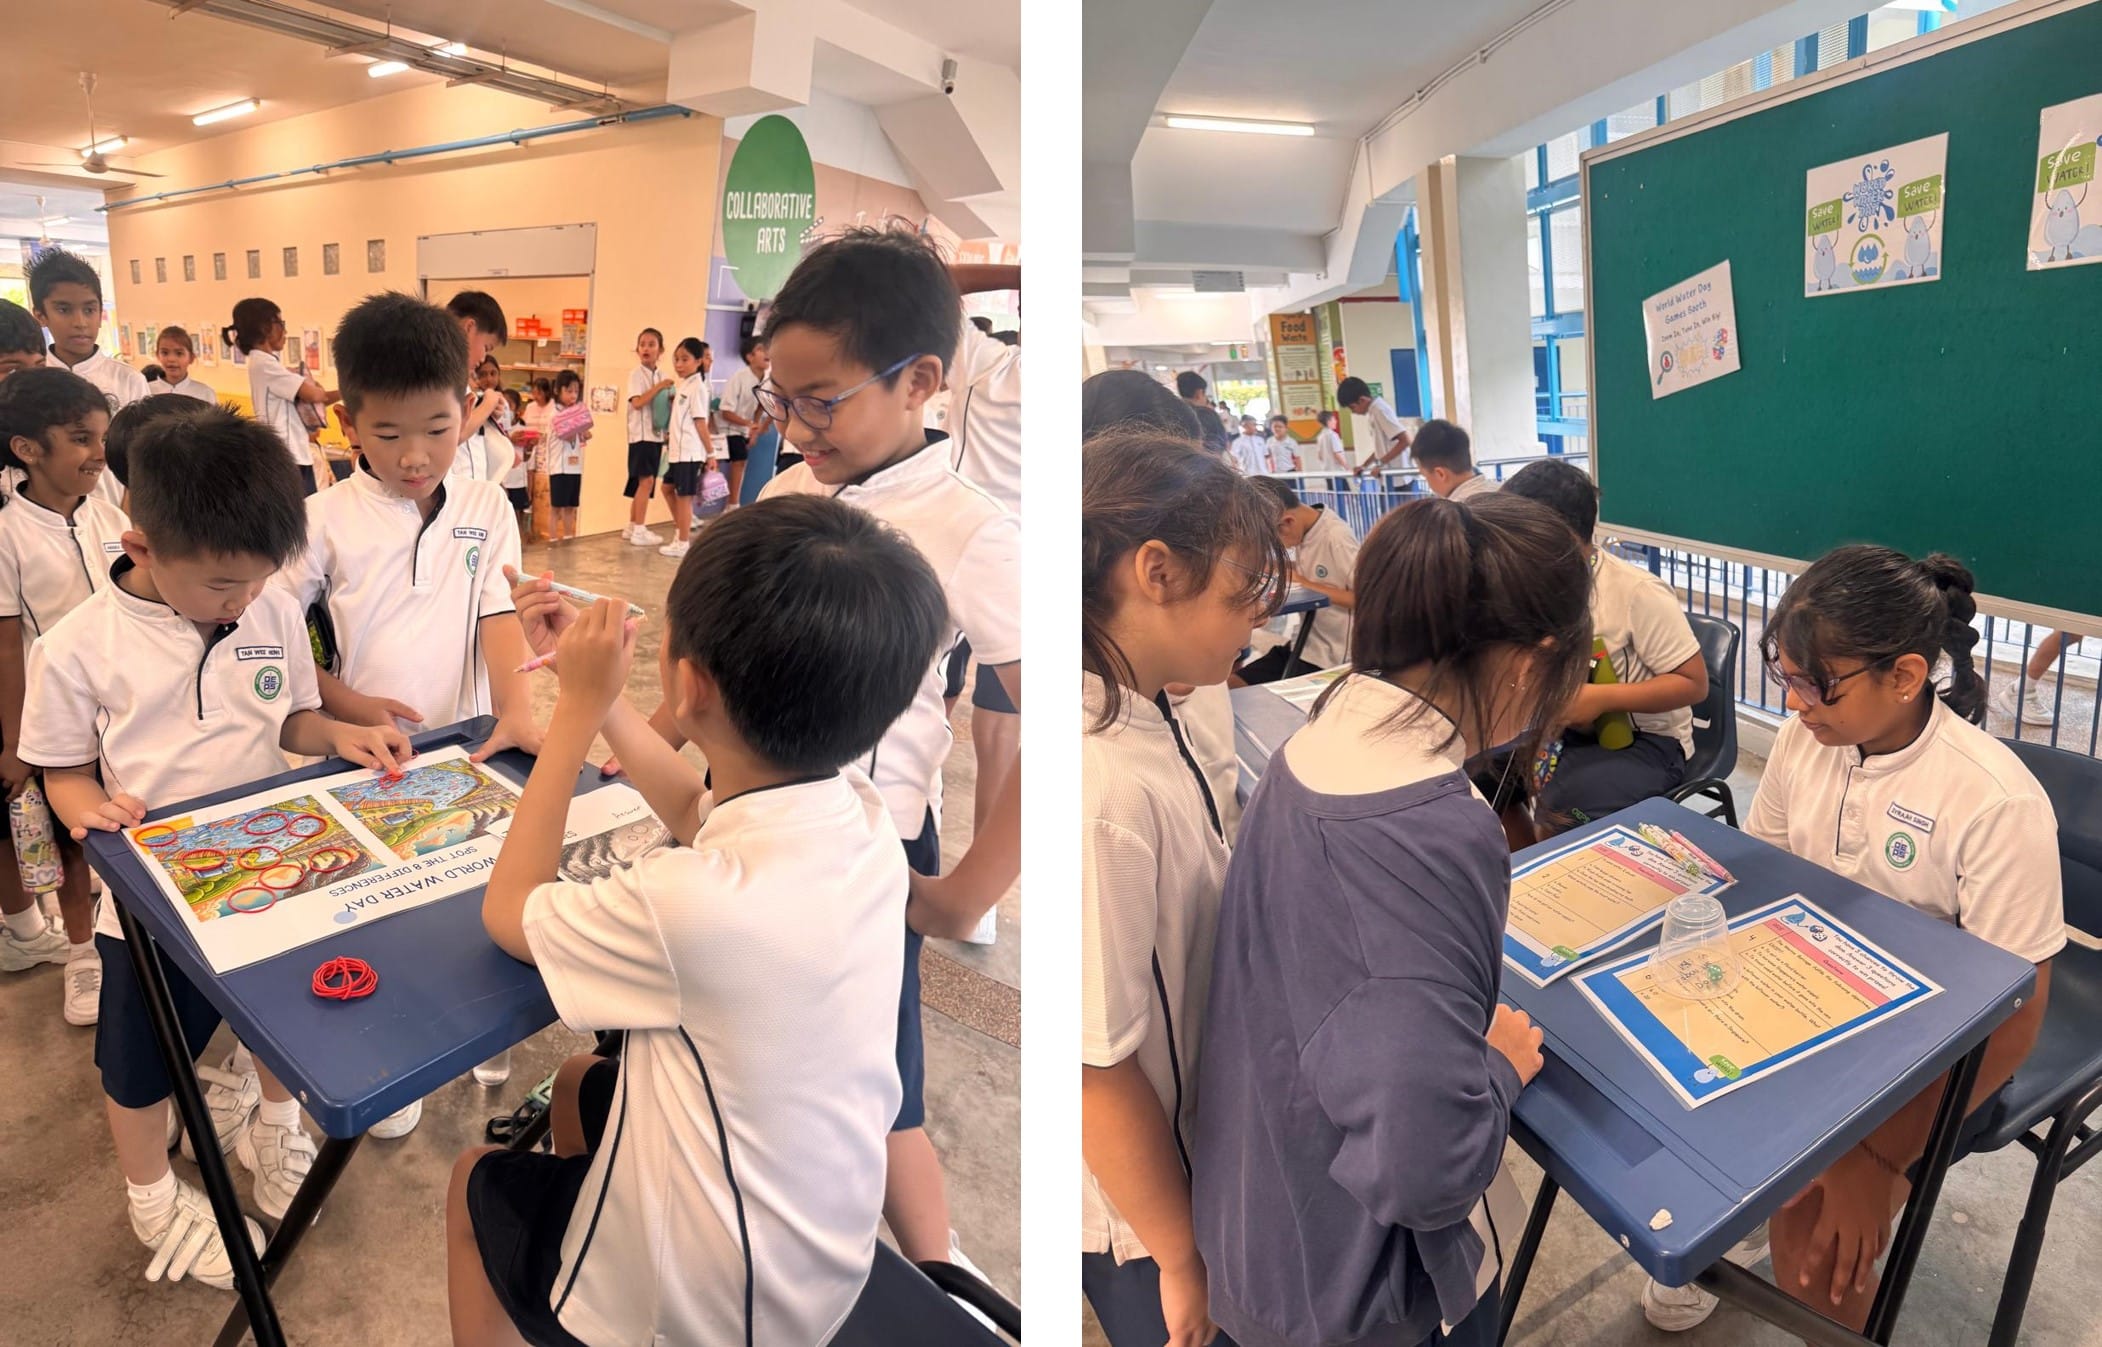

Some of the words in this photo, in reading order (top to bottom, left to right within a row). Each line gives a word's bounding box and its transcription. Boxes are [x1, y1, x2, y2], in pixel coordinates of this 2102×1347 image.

[2047, 151, 2082, 169] Save
[1904, 181, 1931, 198] Save
[726, 191, 812, 220] COLLABORATIVE
[1812, 204, 1834, 219] Save
[1904, 195, 1937, 212] WATER!
[756, 227, 786, 254] ARTS
[1655, 297, 1674, 312] World
[1675, 289, 1697, 303] Water
[1697, 281, 1712, 293] Day
[1280, 320, 1306, 332] Food
[426, 854, 449, 867] THE
[451, 846, 478, 860] SPOT
[412, 863, 421, 871] 8
[444, 856, 497, 879] WORLD
[329, 867, 415, 897] DIFFERENCES
[381, 875, 443, 900] WATER
[345, 894, 380, 913] DAY
